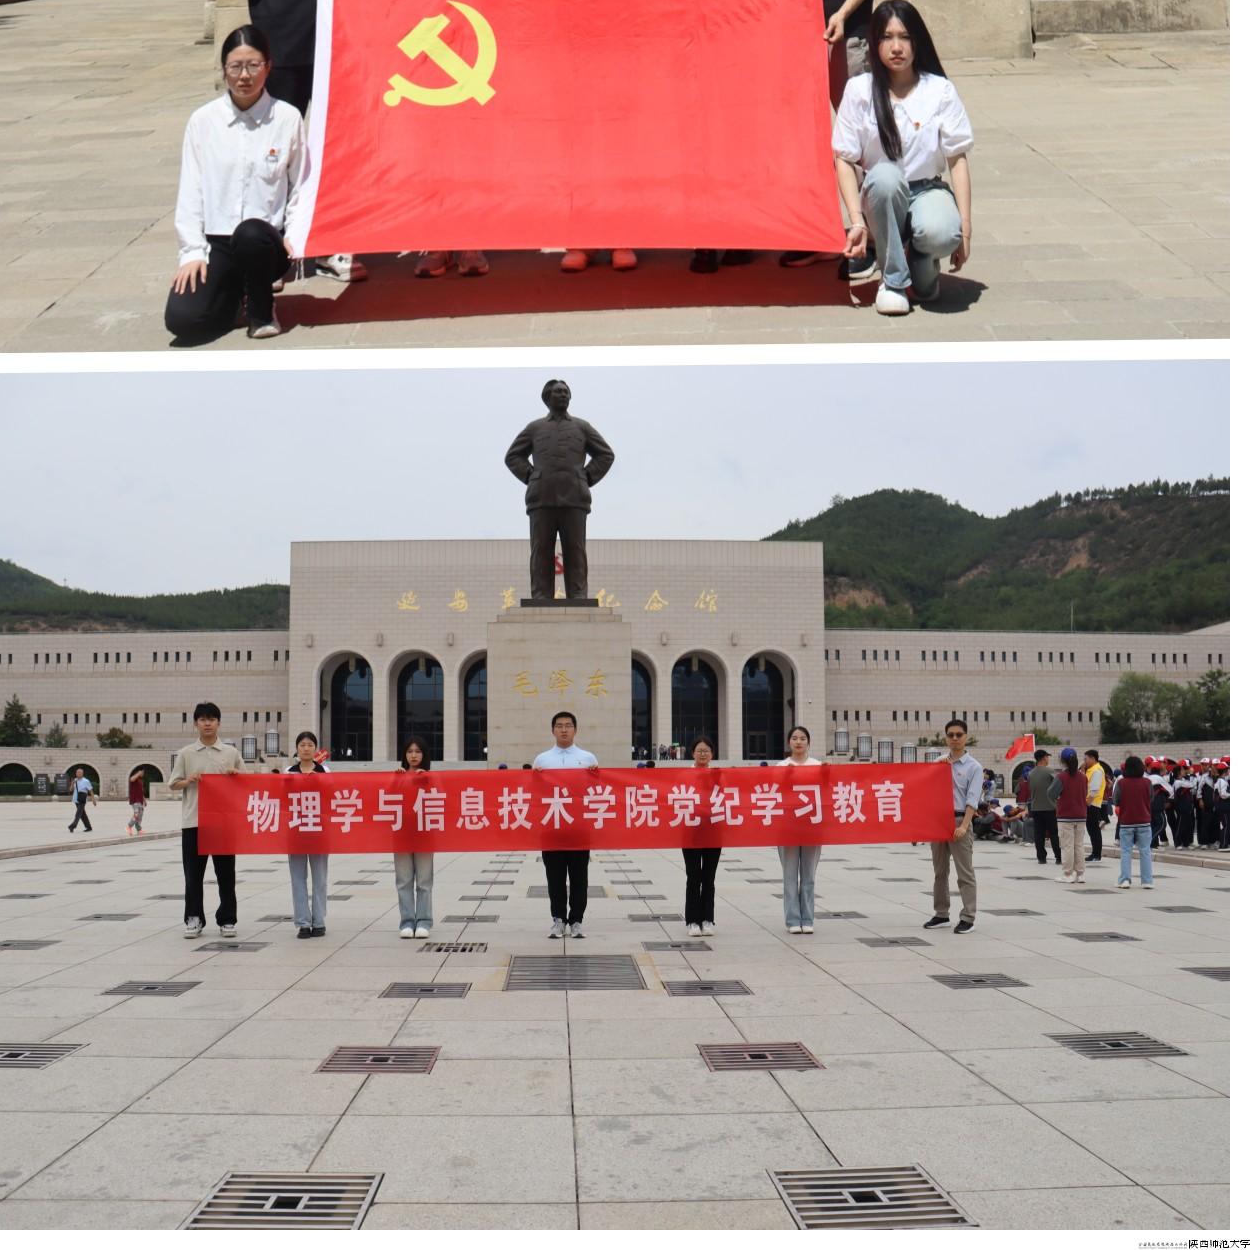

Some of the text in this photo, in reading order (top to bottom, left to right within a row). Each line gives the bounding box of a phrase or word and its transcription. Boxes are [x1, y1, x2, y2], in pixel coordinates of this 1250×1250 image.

[396, 587, 720, 613] 延安革纪念馆
[510, 668, 610, 699] 毛泽东
[245, 780, 906, 834] 物理学与信息技术学院党纪学习教育
